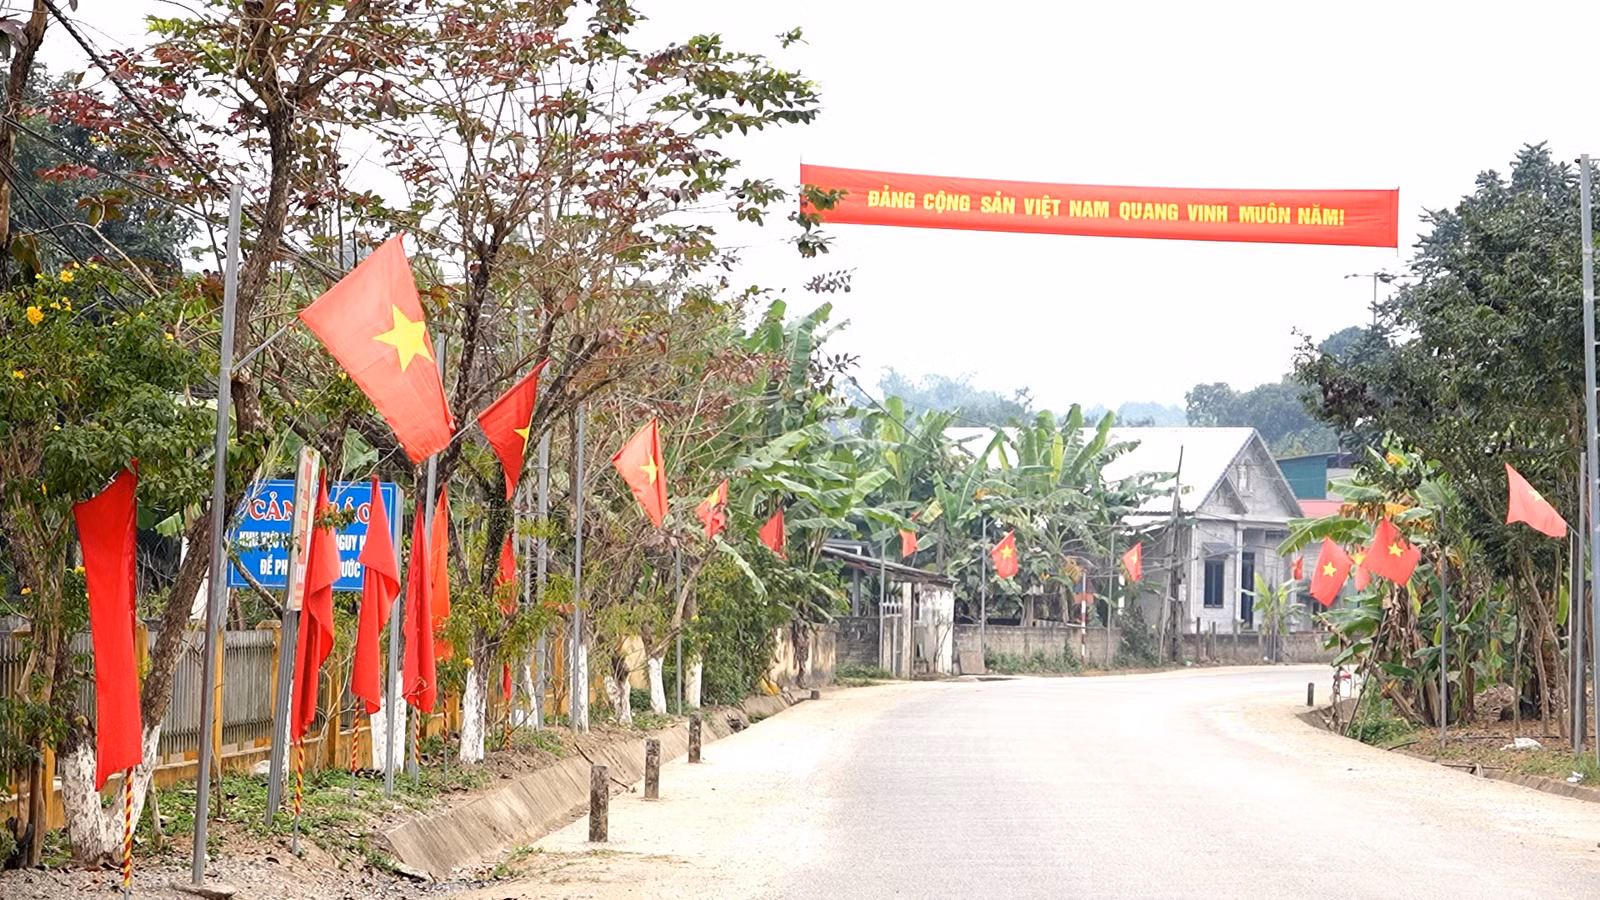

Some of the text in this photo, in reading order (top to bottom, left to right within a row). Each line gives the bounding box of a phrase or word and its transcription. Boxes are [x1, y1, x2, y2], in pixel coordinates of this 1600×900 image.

[868, 184, 1345, 226] ĐẢNG CỘNG SẢN VIỆT NAM QUANG VINH MUÔN NĂM!
[250, 491, 294, 521] CẢN
[341, 558, 361, 578] ƯỚC
